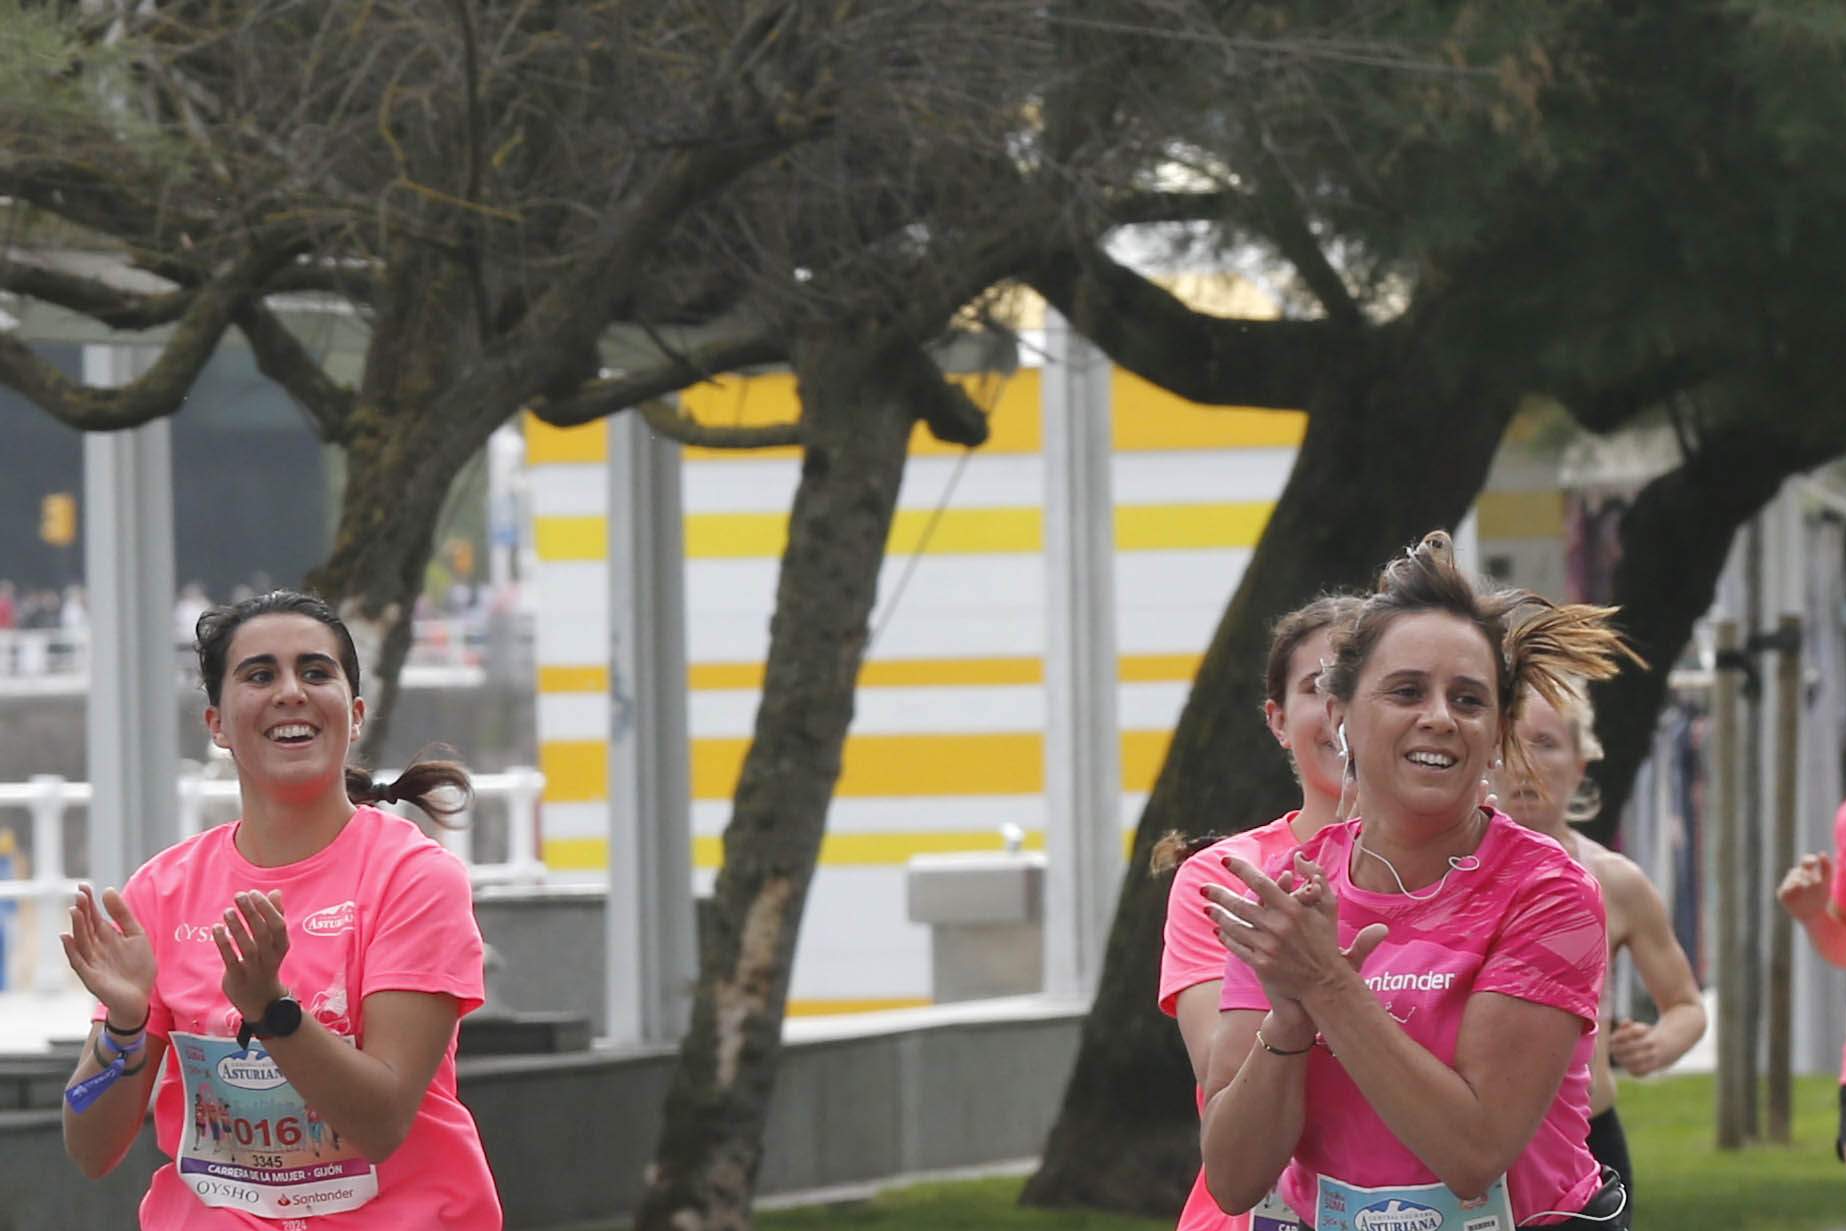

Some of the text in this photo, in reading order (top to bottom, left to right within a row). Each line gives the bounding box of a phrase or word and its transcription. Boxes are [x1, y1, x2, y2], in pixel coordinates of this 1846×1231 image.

[1365, 970, 1456, 992] ntander
[234, 1116, 302, 1148] 016
[252, 1154, 283, 1168] 3345
[272, 1170, 305, 1183] MUJER
[196, 1180, 354, 1207] OYSHO Santander
